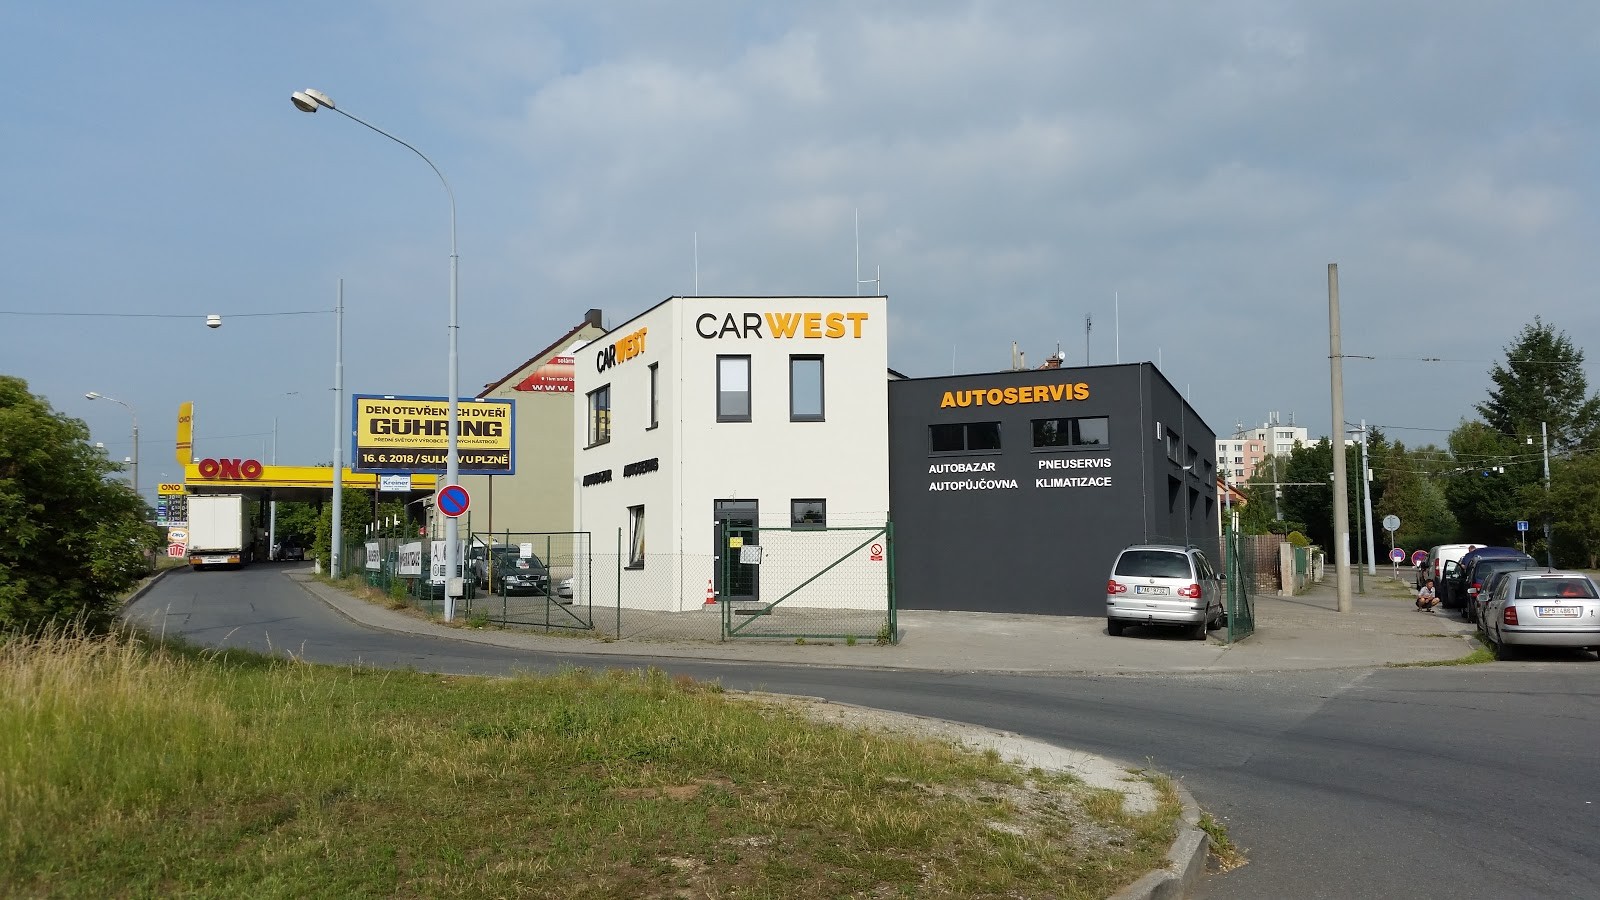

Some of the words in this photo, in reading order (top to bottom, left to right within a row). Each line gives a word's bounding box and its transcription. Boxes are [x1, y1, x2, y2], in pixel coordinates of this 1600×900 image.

[940, 382, 1090, 408] AUTOSERVIS
[366, 406, 390, 414] DEN
[393, 406, 470, 416] OTEVŘENCH
[472, 408, 506, 417] DVEŘÍ
[370, 418, 502, 437] GÜHRING
[363, 454, 376, 463] 16.
[379, 454, 387, 463] 6.
[389, 454, 413, 463] 2018
[421, 455, 464, 464] SULKV
[466, 455, 474, 463] U
[475, 454, 508, 464] PLZNĚ
[1038, 458, 1112, 470] PNEUSERVIS
[199, 458, 262, 479] ONO
[928, 462, 996, 474] AUTOBAZAR
[929, 478, 1018, 491] AUTOPŮJČOVNA
[1035, 477, 1112, 488] KLIMATIZACE
[169, 544, 185, 557] UTA
